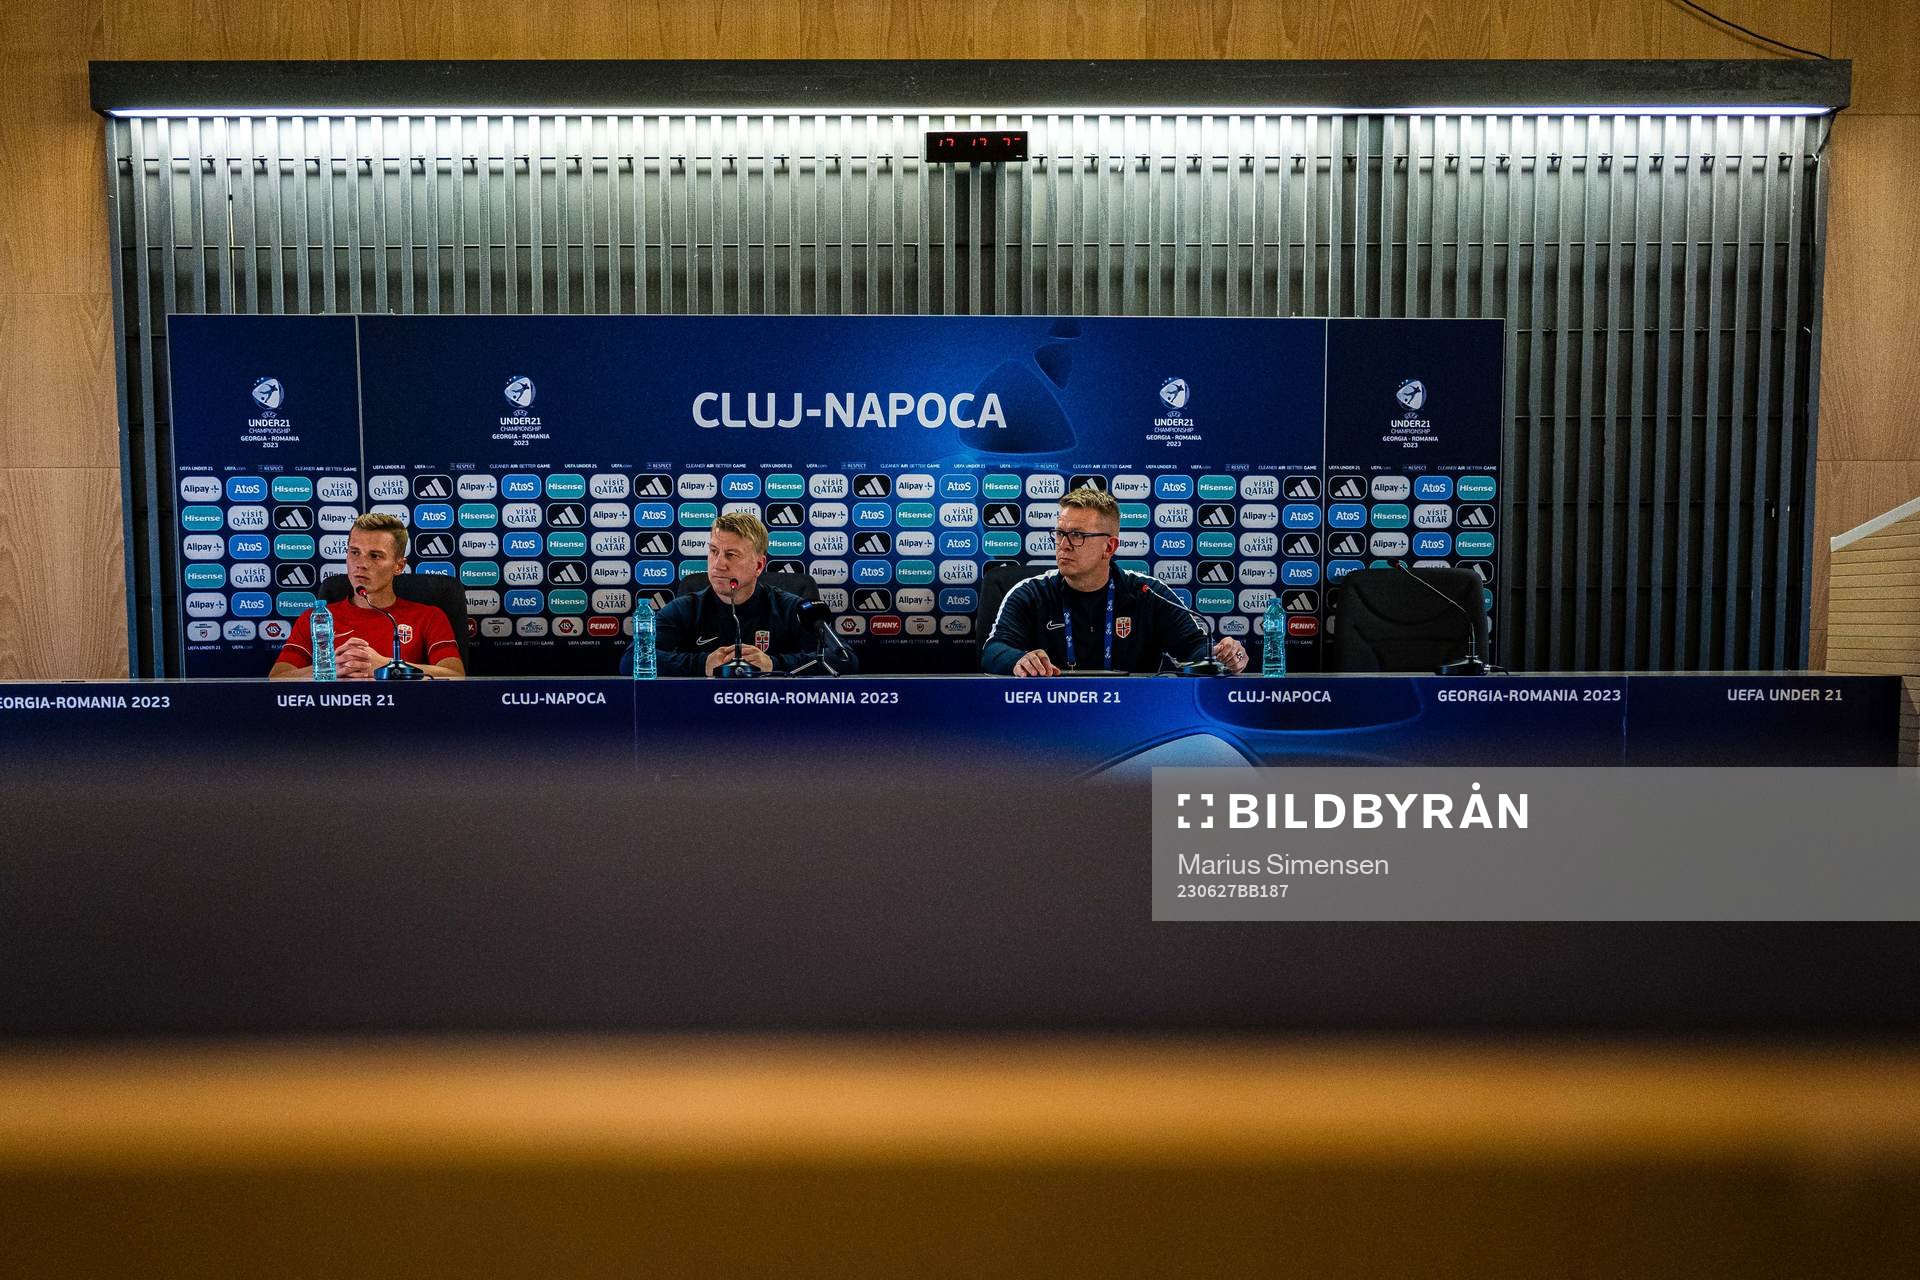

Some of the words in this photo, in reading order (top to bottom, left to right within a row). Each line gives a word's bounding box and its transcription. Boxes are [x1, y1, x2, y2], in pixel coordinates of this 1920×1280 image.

[693, 392, 1006, 428] CLUJ-NAPOCA
[278, 695, 315, 706] UEFA
[320, 694, 371, 706] UNDER
[377, 695, 394, 706] 21
[502, 692, 606, 704] CLUJ-NAPOCA
[714, 692, 855, 704] GEORGIA-ROMANIA
[861, 692, 898, 703] 2023
[1005, 692, 1042, 703] UEFA
[1048, 692, 1098, 703] UNDER
[1103, 692, 1120, 703] 21
[1228, 691, 1331, 702] CLUJ-NAPOCA
[1438, 690, 1578, 702] GEORGIA-ROMANIA
[1583, 690, 1620, 701] 2023
[1728, 689, 1764, 700] UEFA
[1770, 689, 1820, 700] UNDER
[1825, 690, 1842, 700] 21
[132, 696, 170, 708] 2023
